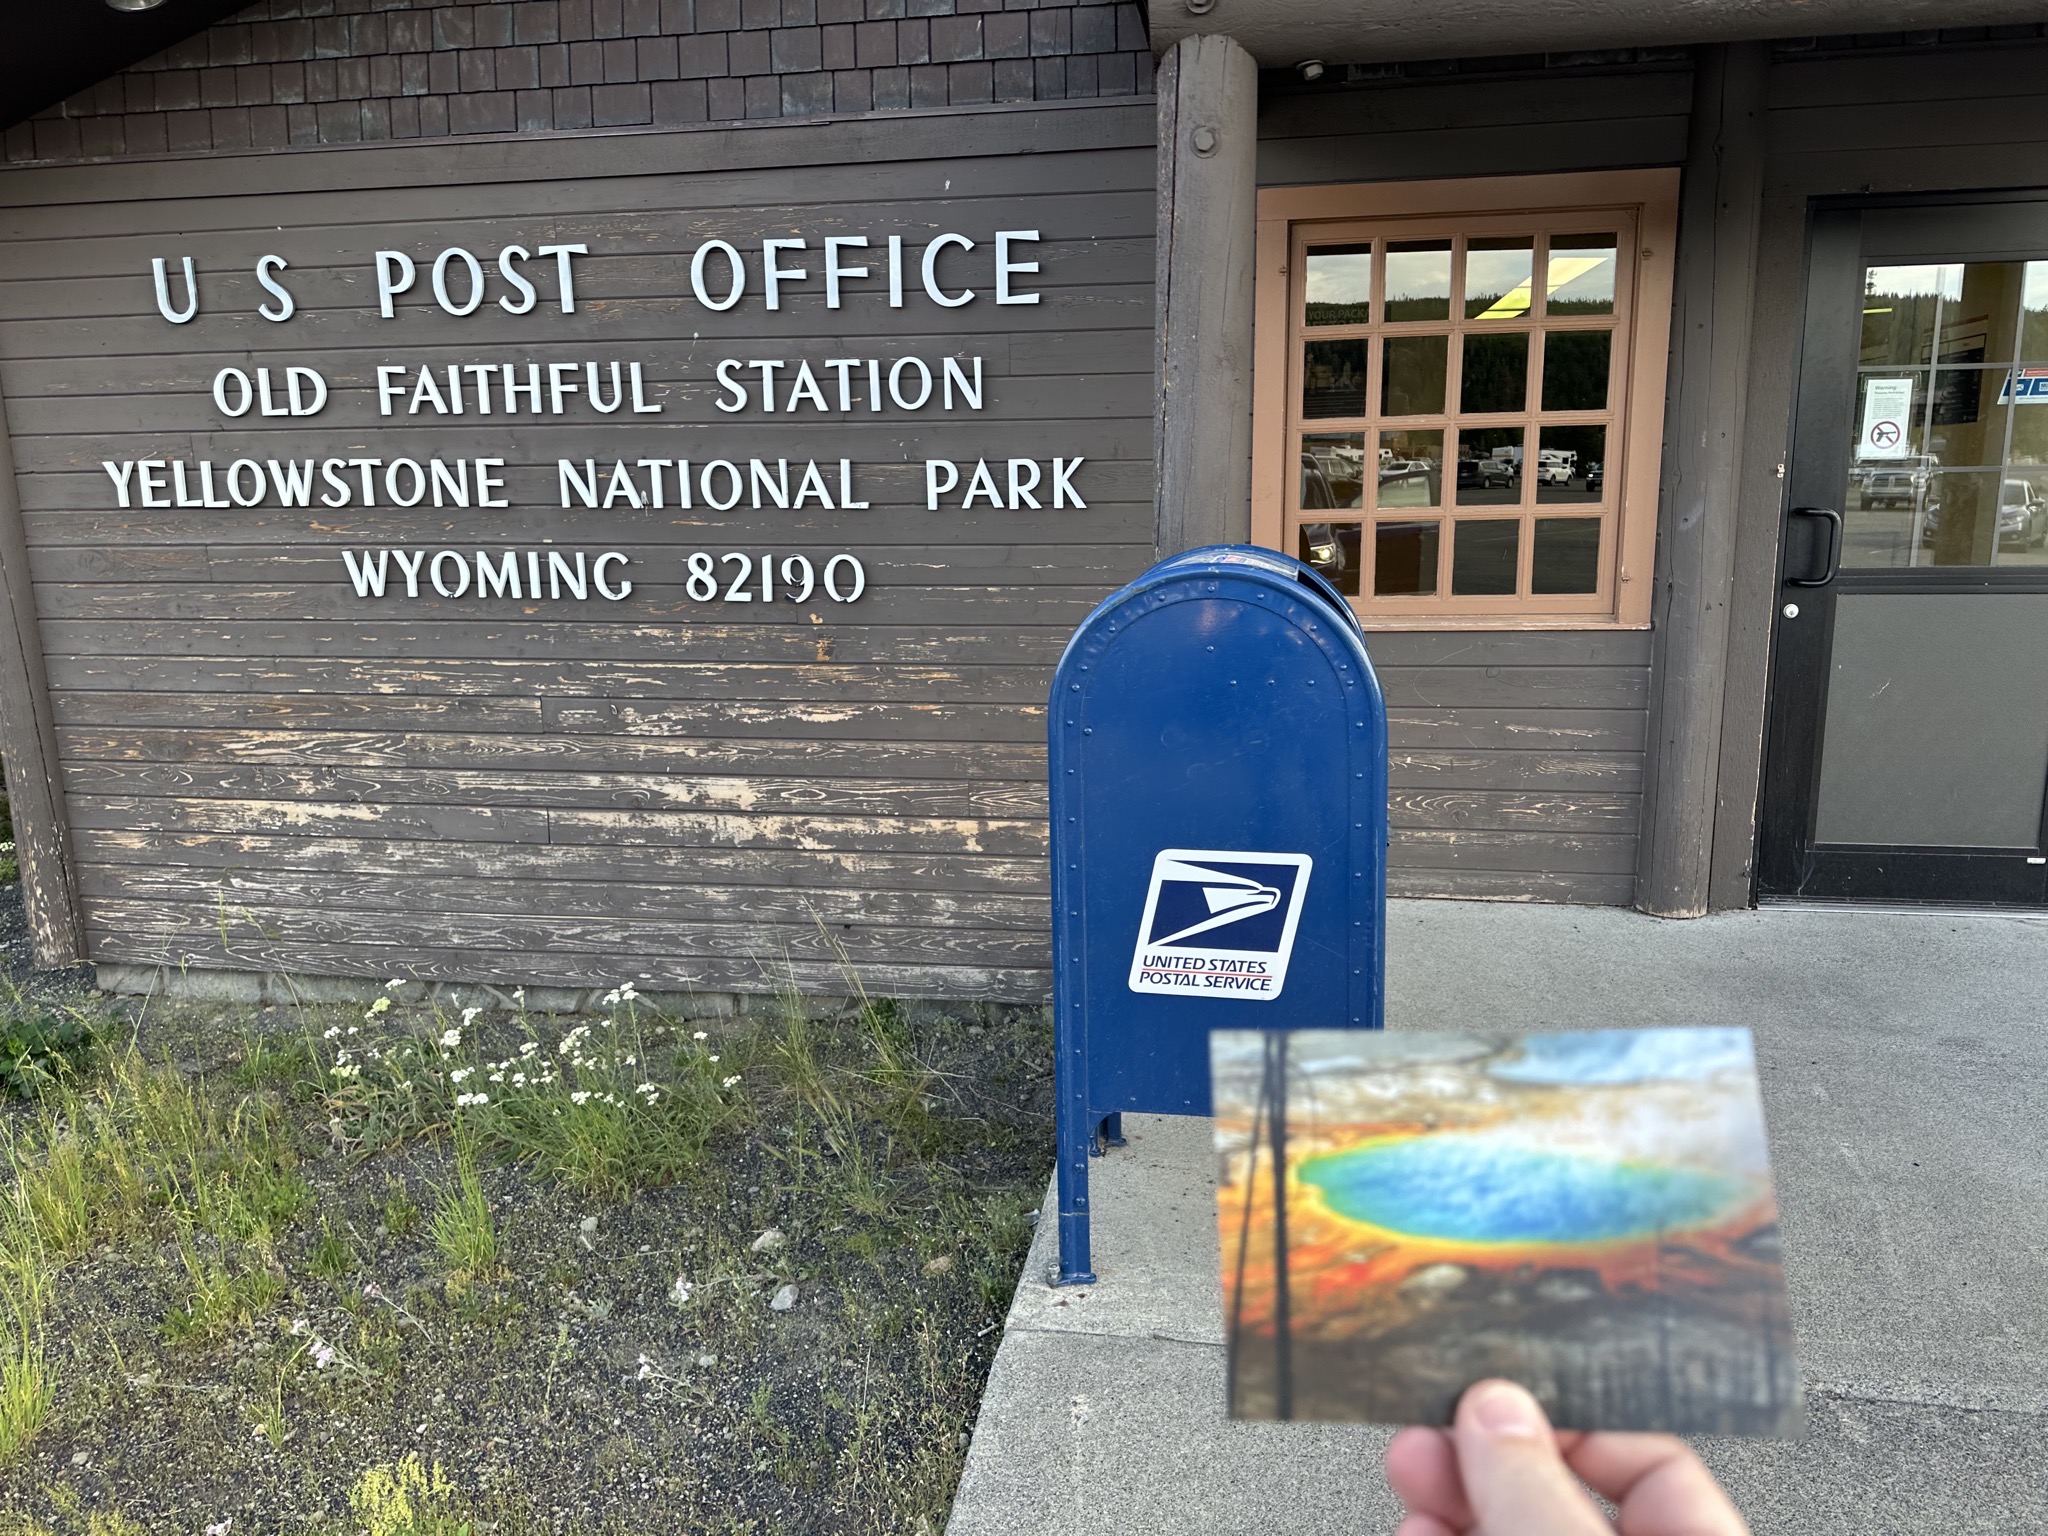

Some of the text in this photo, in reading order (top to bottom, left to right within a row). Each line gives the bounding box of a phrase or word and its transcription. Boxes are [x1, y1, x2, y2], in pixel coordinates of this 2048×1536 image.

[151, 229, 1042, 324] U S POST OFFICE
[1307, 310, 1336, 320] YOUR
[212, 356, 984, 418] OLD FAITHFUL STATION
[101, 456, 1088, 512] YELLOWSTONE NATIONAL PARK
[341, 549, 867, 605] WYOMING 82190
[1139, 971, 1272, 991] POSTAL SERVICE
[1143, 955, 1267, 974] UNITED STATES
